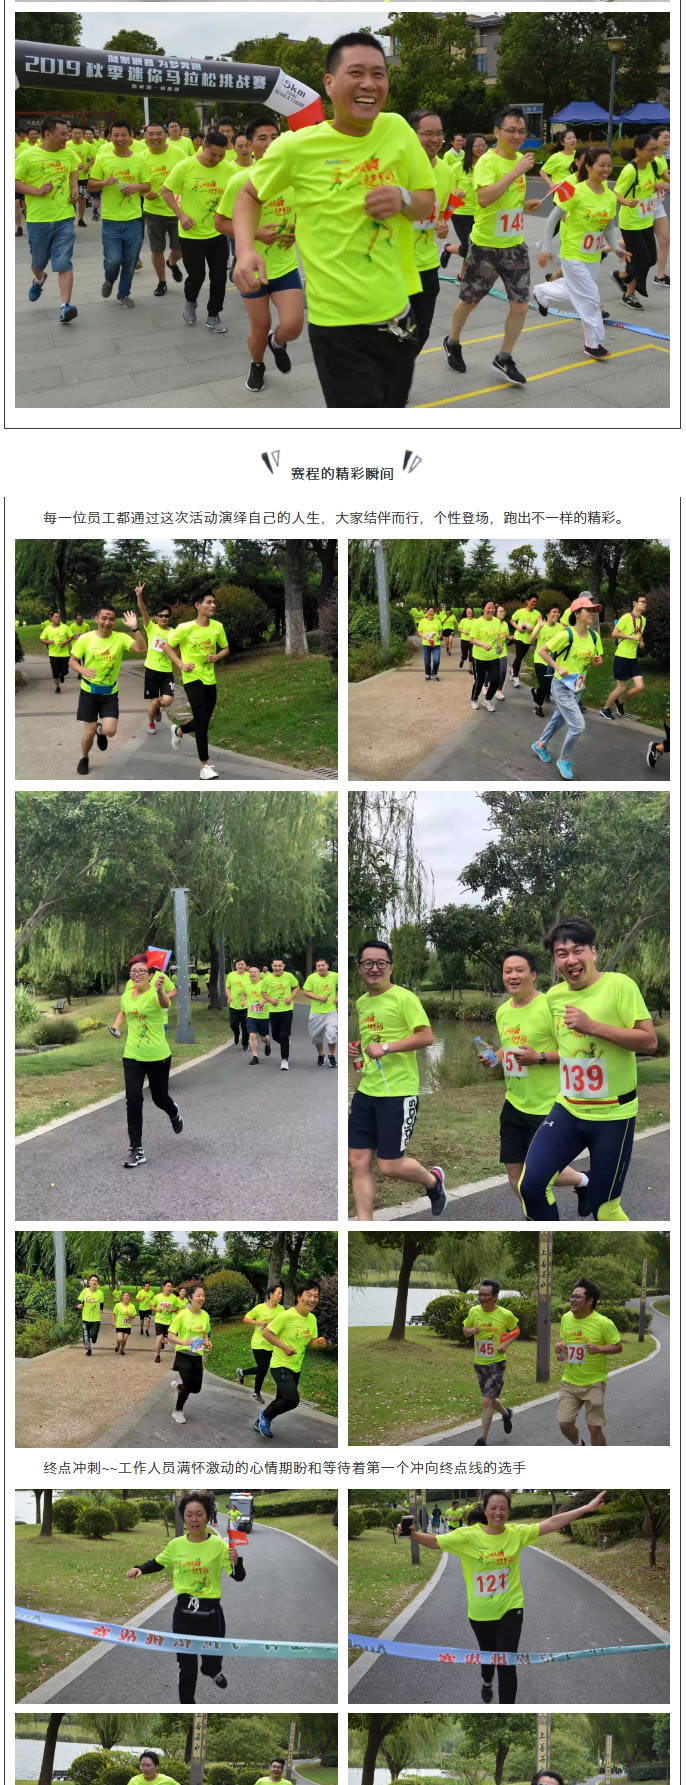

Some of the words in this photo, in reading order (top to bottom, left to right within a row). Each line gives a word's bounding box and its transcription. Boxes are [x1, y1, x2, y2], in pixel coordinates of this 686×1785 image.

[283, 79, 306, 99] 5km
[562, 1064, 604, 1092] 139
[476, 1573, 507, 1593] 121
